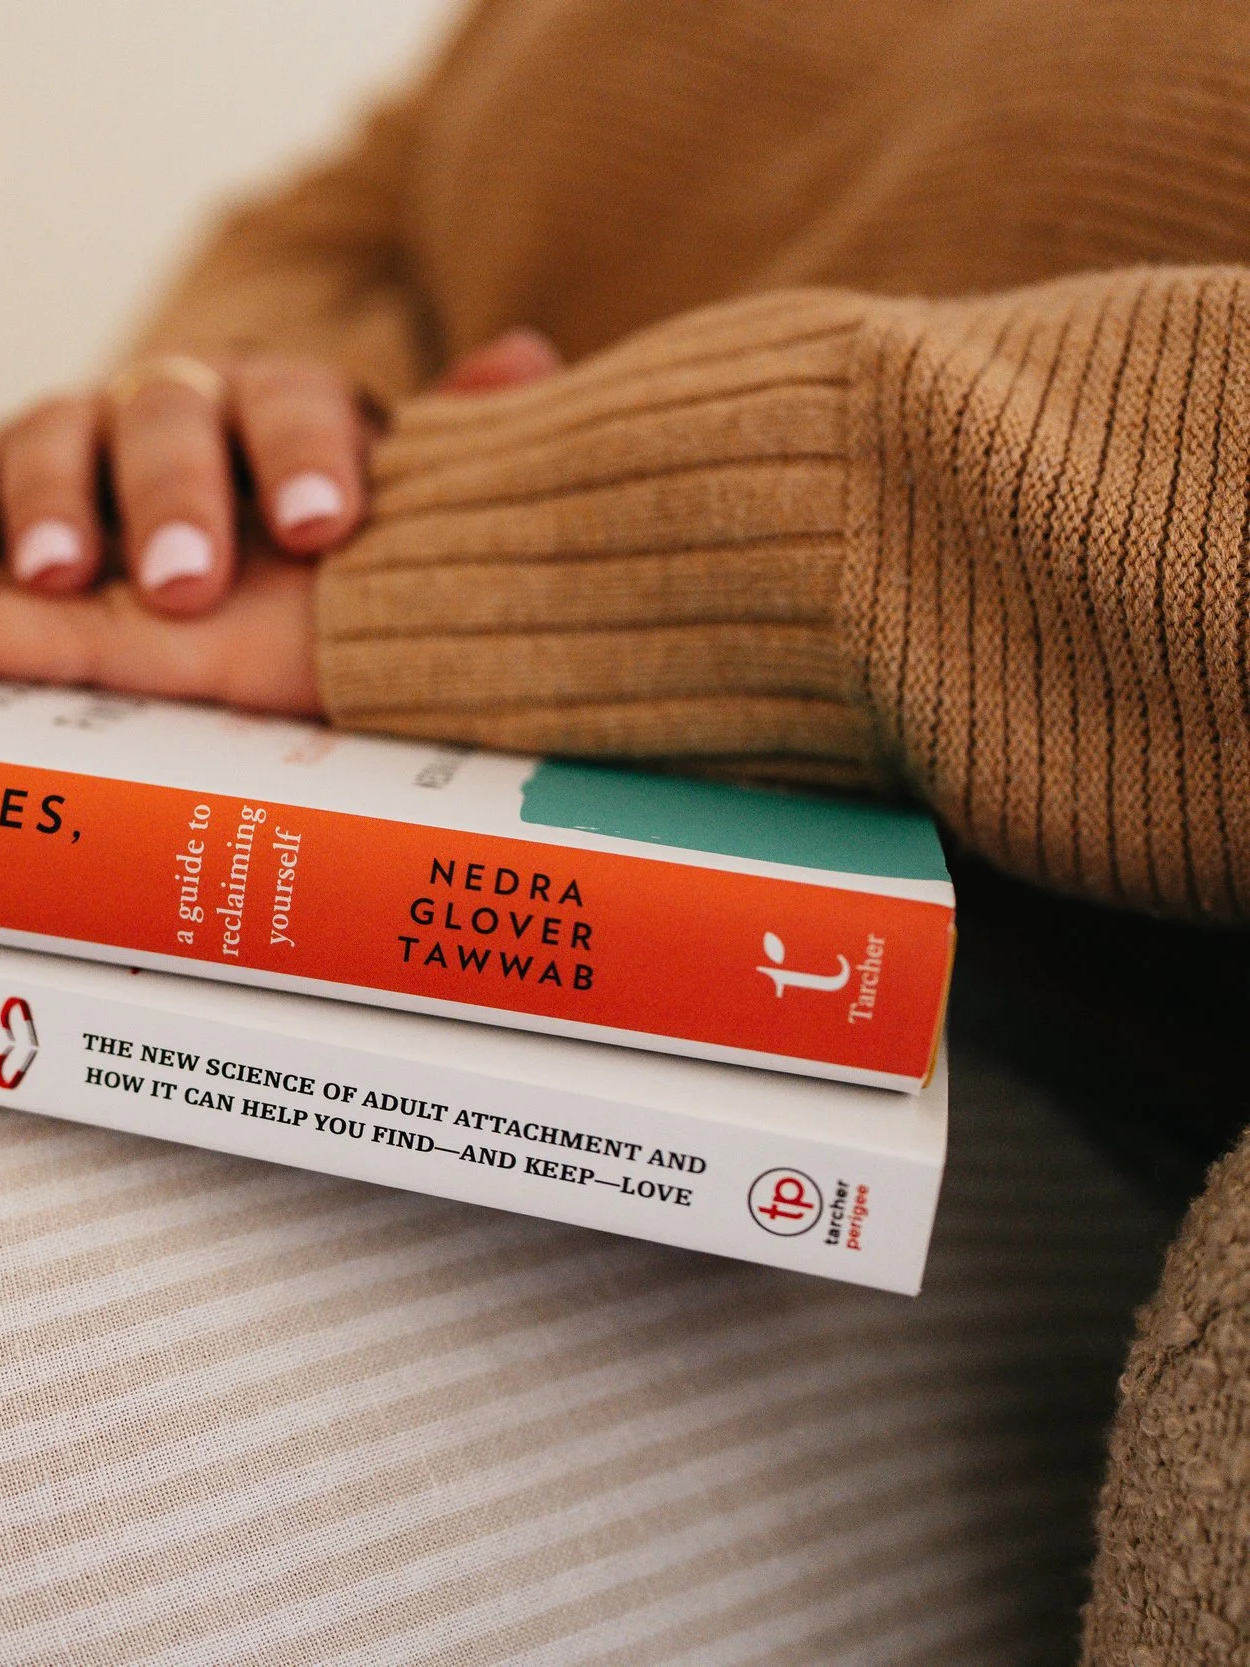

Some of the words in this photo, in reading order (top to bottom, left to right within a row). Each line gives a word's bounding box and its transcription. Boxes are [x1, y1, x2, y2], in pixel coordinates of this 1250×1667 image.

[188, 804, 212, 831] to
[175, 841, 205, 924] guide
[217, 804, 267, 957] reclaiming
[270, 826, 302, 948] yourself
[430, 858, 583, 907] NEDRA
[177, 930, 194, 945] a
[410, 898, 593, 950] GLOVER
[398, 936, 594, 991] TAWWAB
[848, 933, 885, 1024] Tarcher
[82, 1033, 133, 1059] THE
[141, 1045, 200, 1072] NEW
[206, 1058, 315, 1095] SCIENCE
[323, 1082, 357, 1103] OF
[361, 1091, 449, 1123] ADULT
[453, 1110, 642, 1162] ATTACHMENT
[647, 1149, 707, 1174] AND
[86, 1066, 144, 1094] HOW
[151, 1080, 178, 1100] IT
[184, 1087, 235, 1113] CAN
[240, 1098, 308, 1127] HELP
[314, 1114, 364, 1139] YOU
[758, 1176, 814, 1220] tp
[825, 1179, 850, 1245] tarcher
[846, 1184, 869, 1251] perigee
